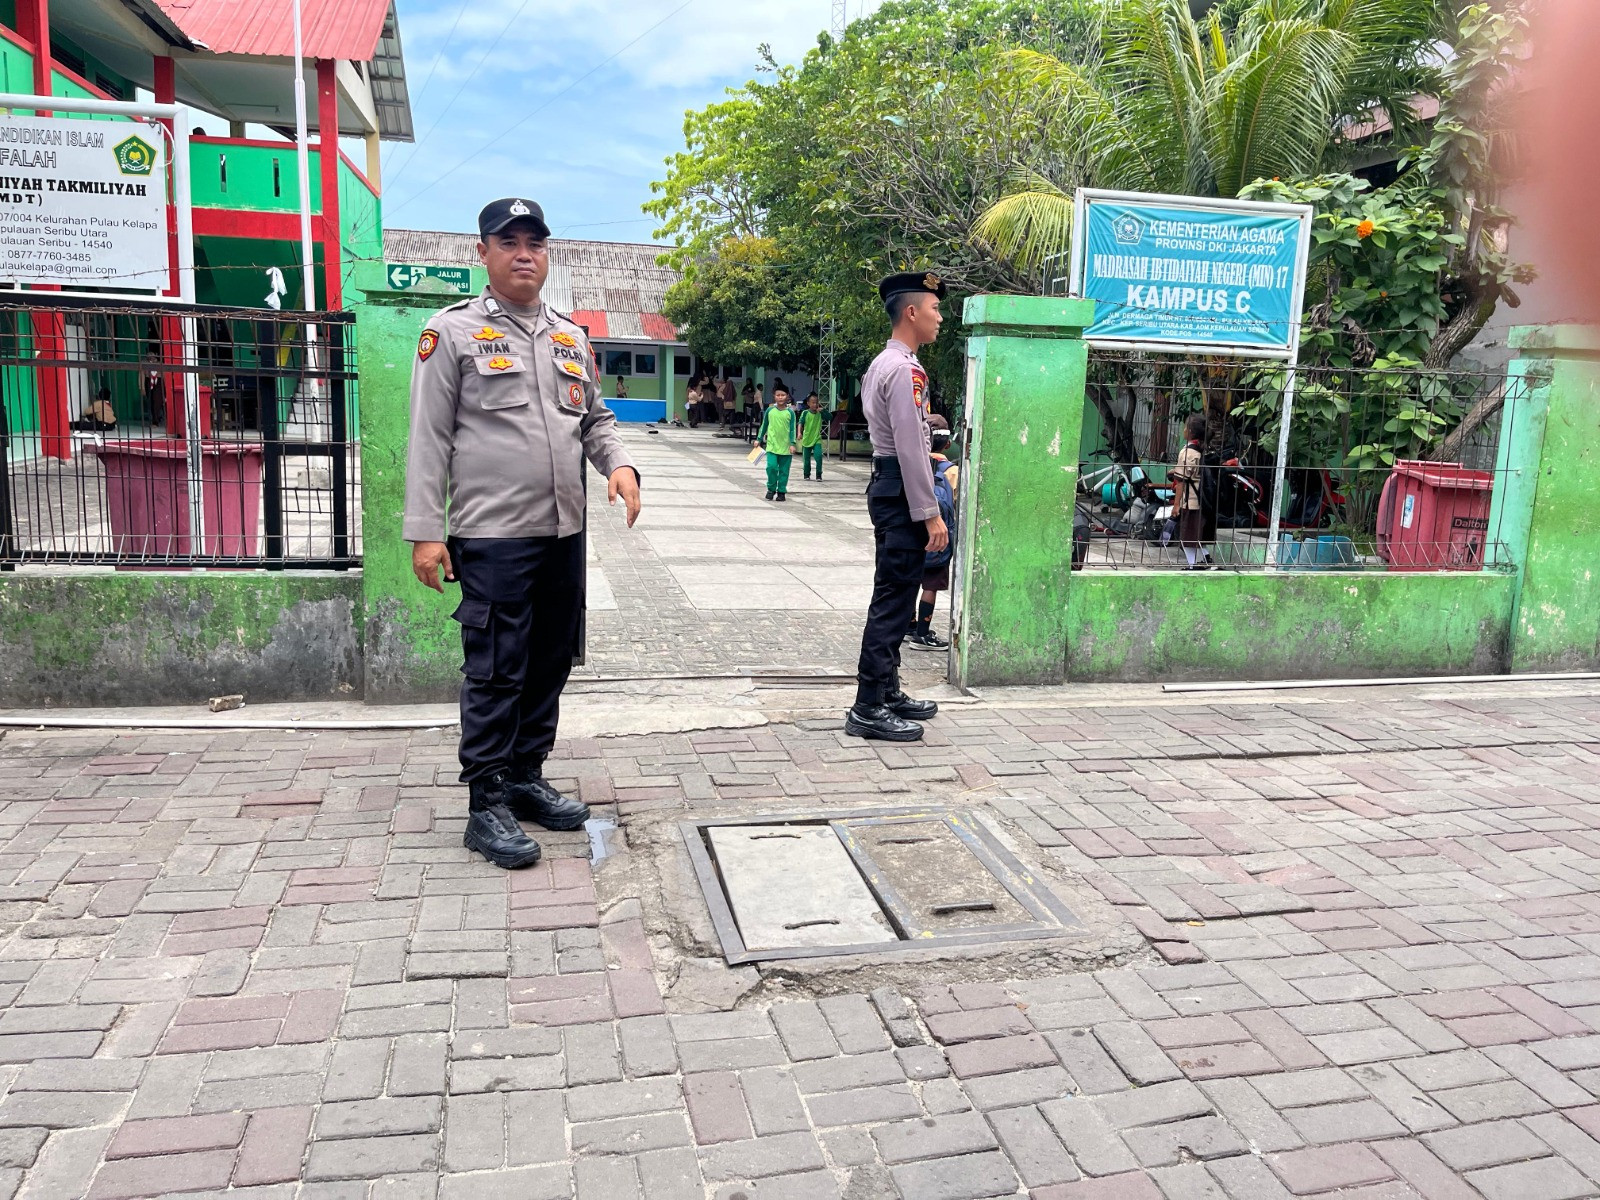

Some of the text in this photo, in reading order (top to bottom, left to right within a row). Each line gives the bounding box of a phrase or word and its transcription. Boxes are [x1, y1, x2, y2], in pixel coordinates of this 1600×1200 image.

[0, 126, 104, 149] NDIDIKAN ISLAM
[46, 179, 147, 197] TAKMILIYAH
[35, 214, 87, 225] Kelurahan
[90, 217, 119, 227] Pulau
[122, 219, 158, 230] Kelapa
[44, 226, 77, 237] Seribu
[80, 228, 108, 238] Utara
[1149, 220, 1285, 245] KEMENTERIAN AGAMA
[38, 237, 71, 248] Seribu
[82, 240, 113, 250] 14540
[1155, 238, 1278, 256] PROVINSI DKI JAKARTA
[7, 249, 92, 262] 0877-7760-3485
[436, 270, 462, 279] JALUR
[1092, 253, 1289, 290] MADRASAH IBTIDAIYAH NEGERI (MIN) 17
[1126, 284, 1252, 314] KAMPUS C
[478, 342, 510, 354] IWAN
[554, 346, 584, 362] POLRI
[1454, 518, 1487, 529] Dalton
